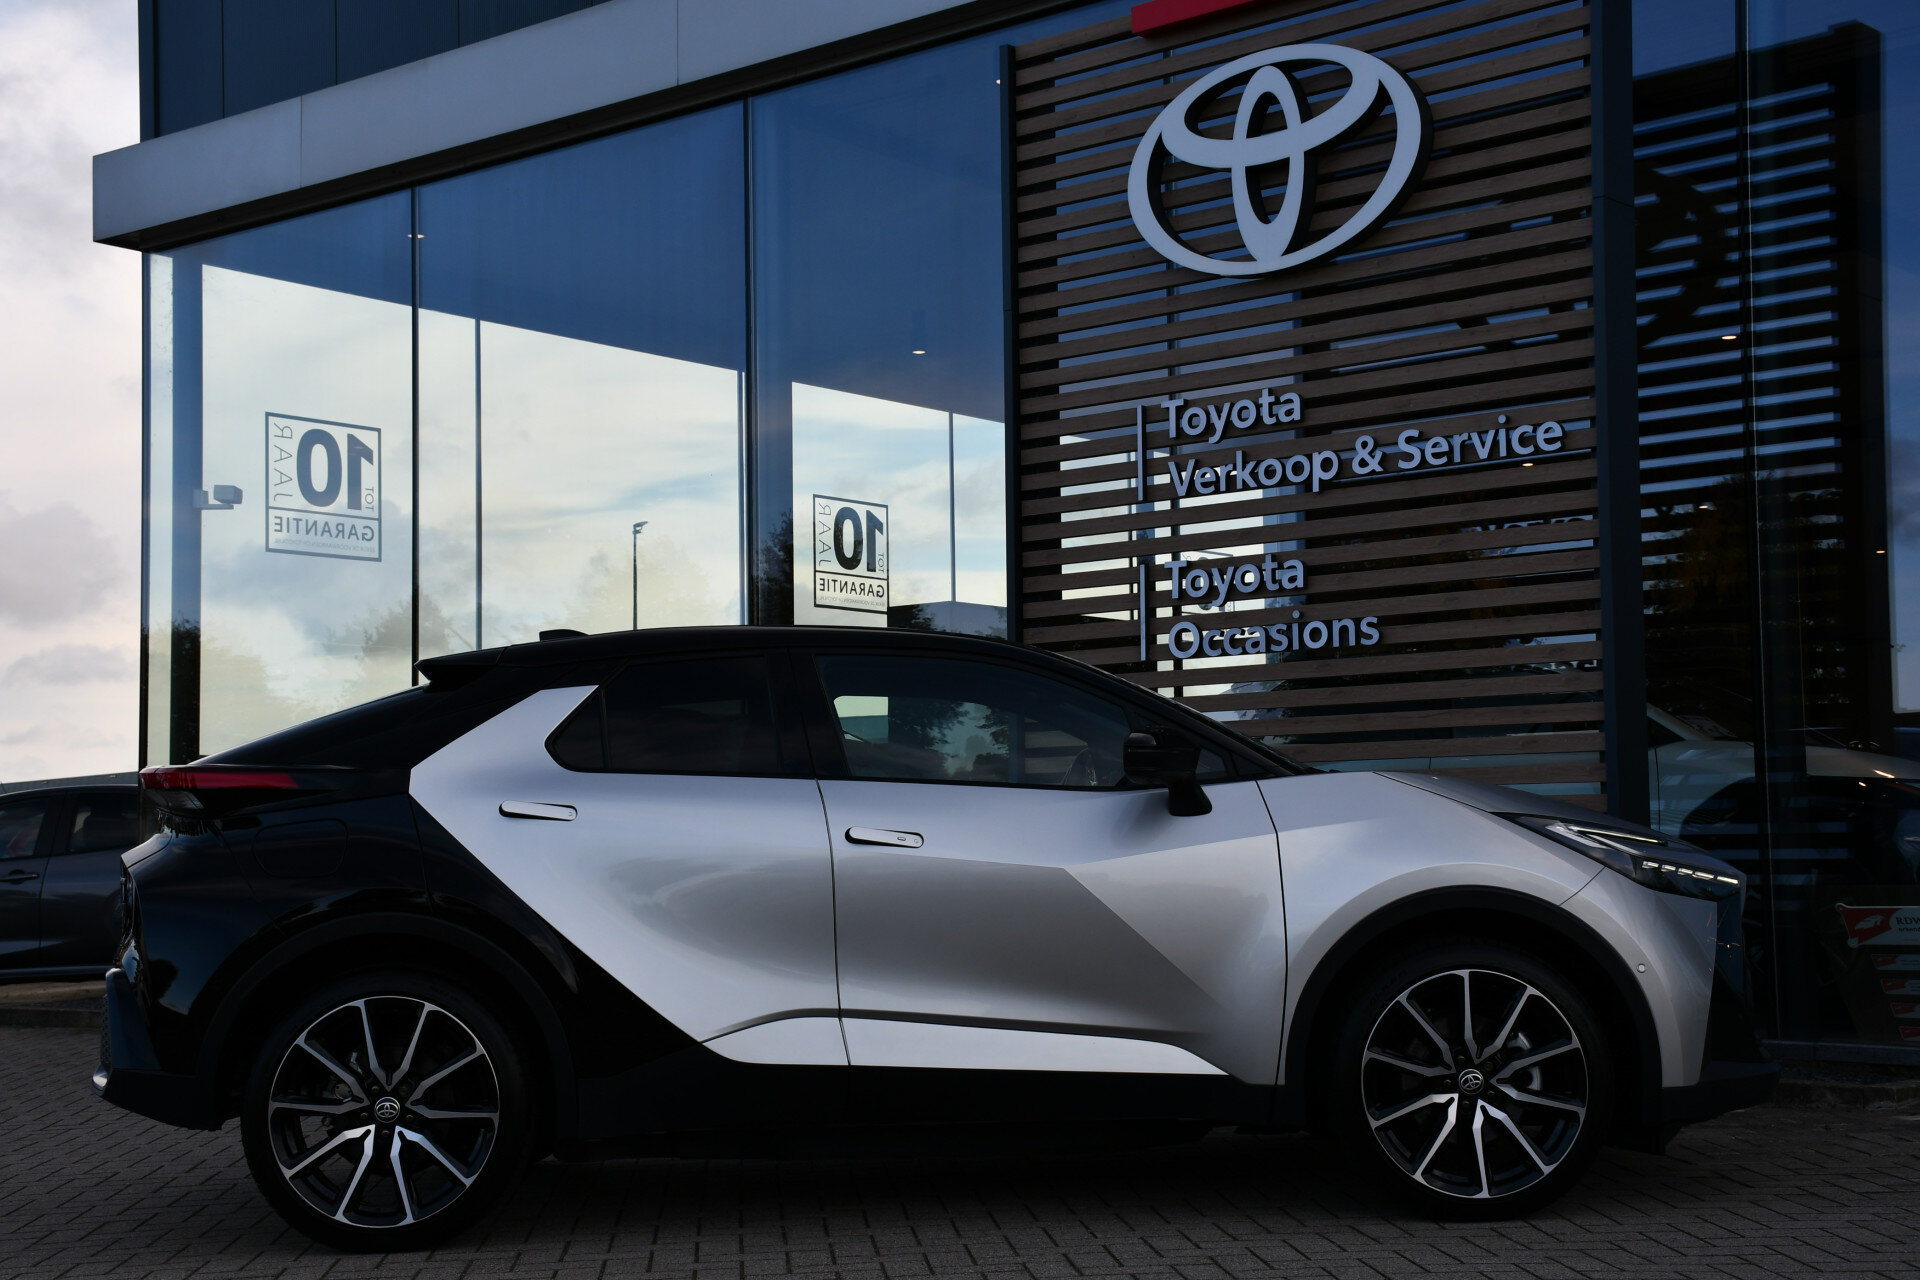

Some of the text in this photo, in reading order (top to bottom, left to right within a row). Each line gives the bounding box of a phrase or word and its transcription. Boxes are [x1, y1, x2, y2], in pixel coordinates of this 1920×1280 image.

[1161, 388, 1301, 444] Toyota
[1168, 414, 1563, 497] Verkoop & Service
[1163, 553, 1304, 608] Toyota
[1168, 609, 1380, 659] Occasions
